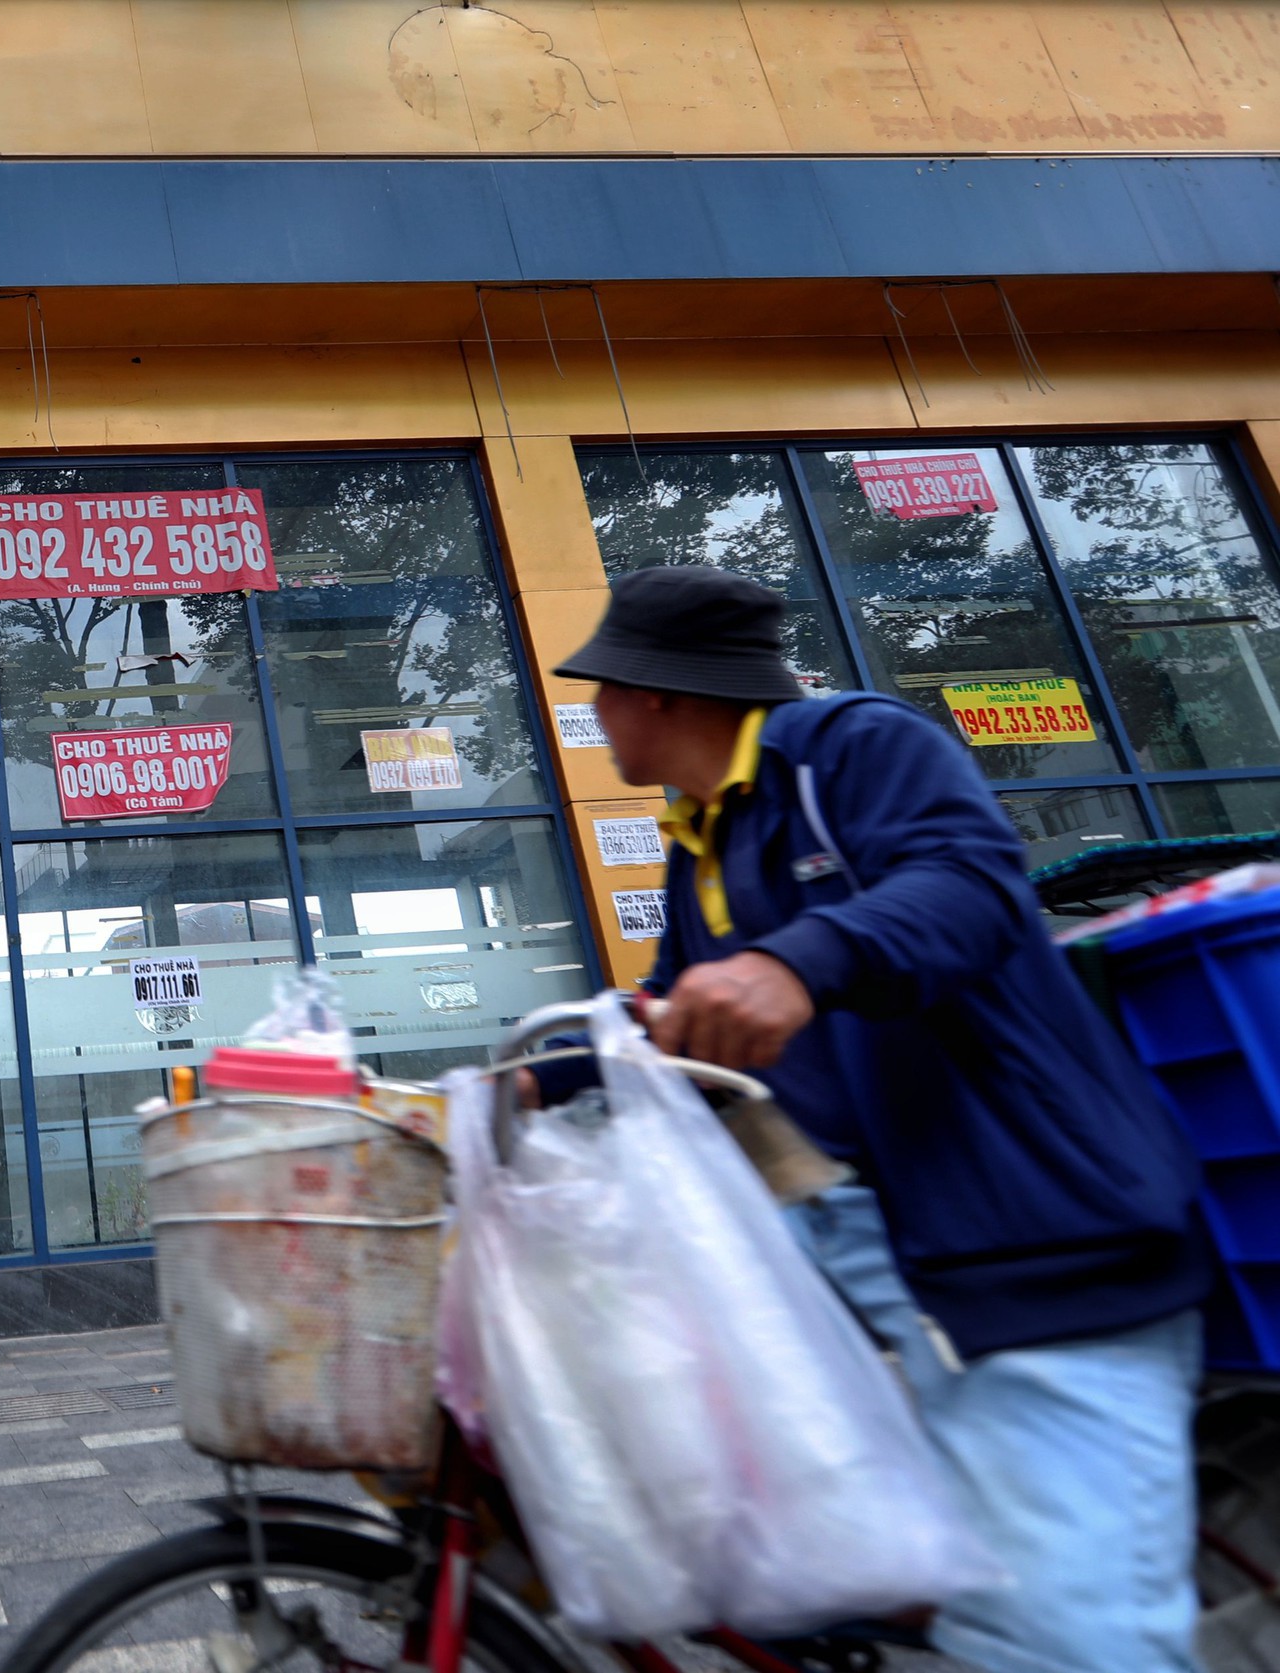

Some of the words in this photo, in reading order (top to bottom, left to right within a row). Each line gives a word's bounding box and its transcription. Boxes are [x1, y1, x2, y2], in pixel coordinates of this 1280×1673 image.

[857, 466, 878, 478] CHO
[878, 461, 904, 475] THUÊ
[905, 460, 924, 474] NHÀ
[75, 495, 170, 520] THUÊ
[180, 490, 257, 518] NHÀ
[864, 473, 988, 509] 0931.339.227
[80, 525, 158, 578] 432
[165, 520, 267, 576] 5858
[67, 583, 86, 594] (A.
[88, 582, 121, 594] Hưng
[132, 580, 169, 592] Chính
[173, 578, 202, 591] Chủ)
[58, 739, 106, 760] CHO
[112, 732, 173, 757] THUÊ
[179, 728, 228, 751] NHÀ
[372, 761, 407, 789] 0932
[125, 797, 149, 810] (Cô
[616, 894, 633, 904] CHO
[134, 963, 151, 974] CHO
[153, 960, 176, 973] THUÊ
[176, 957, 196, 971] NHÀ
[134, 973, 201, 1002] 0917.111.661
